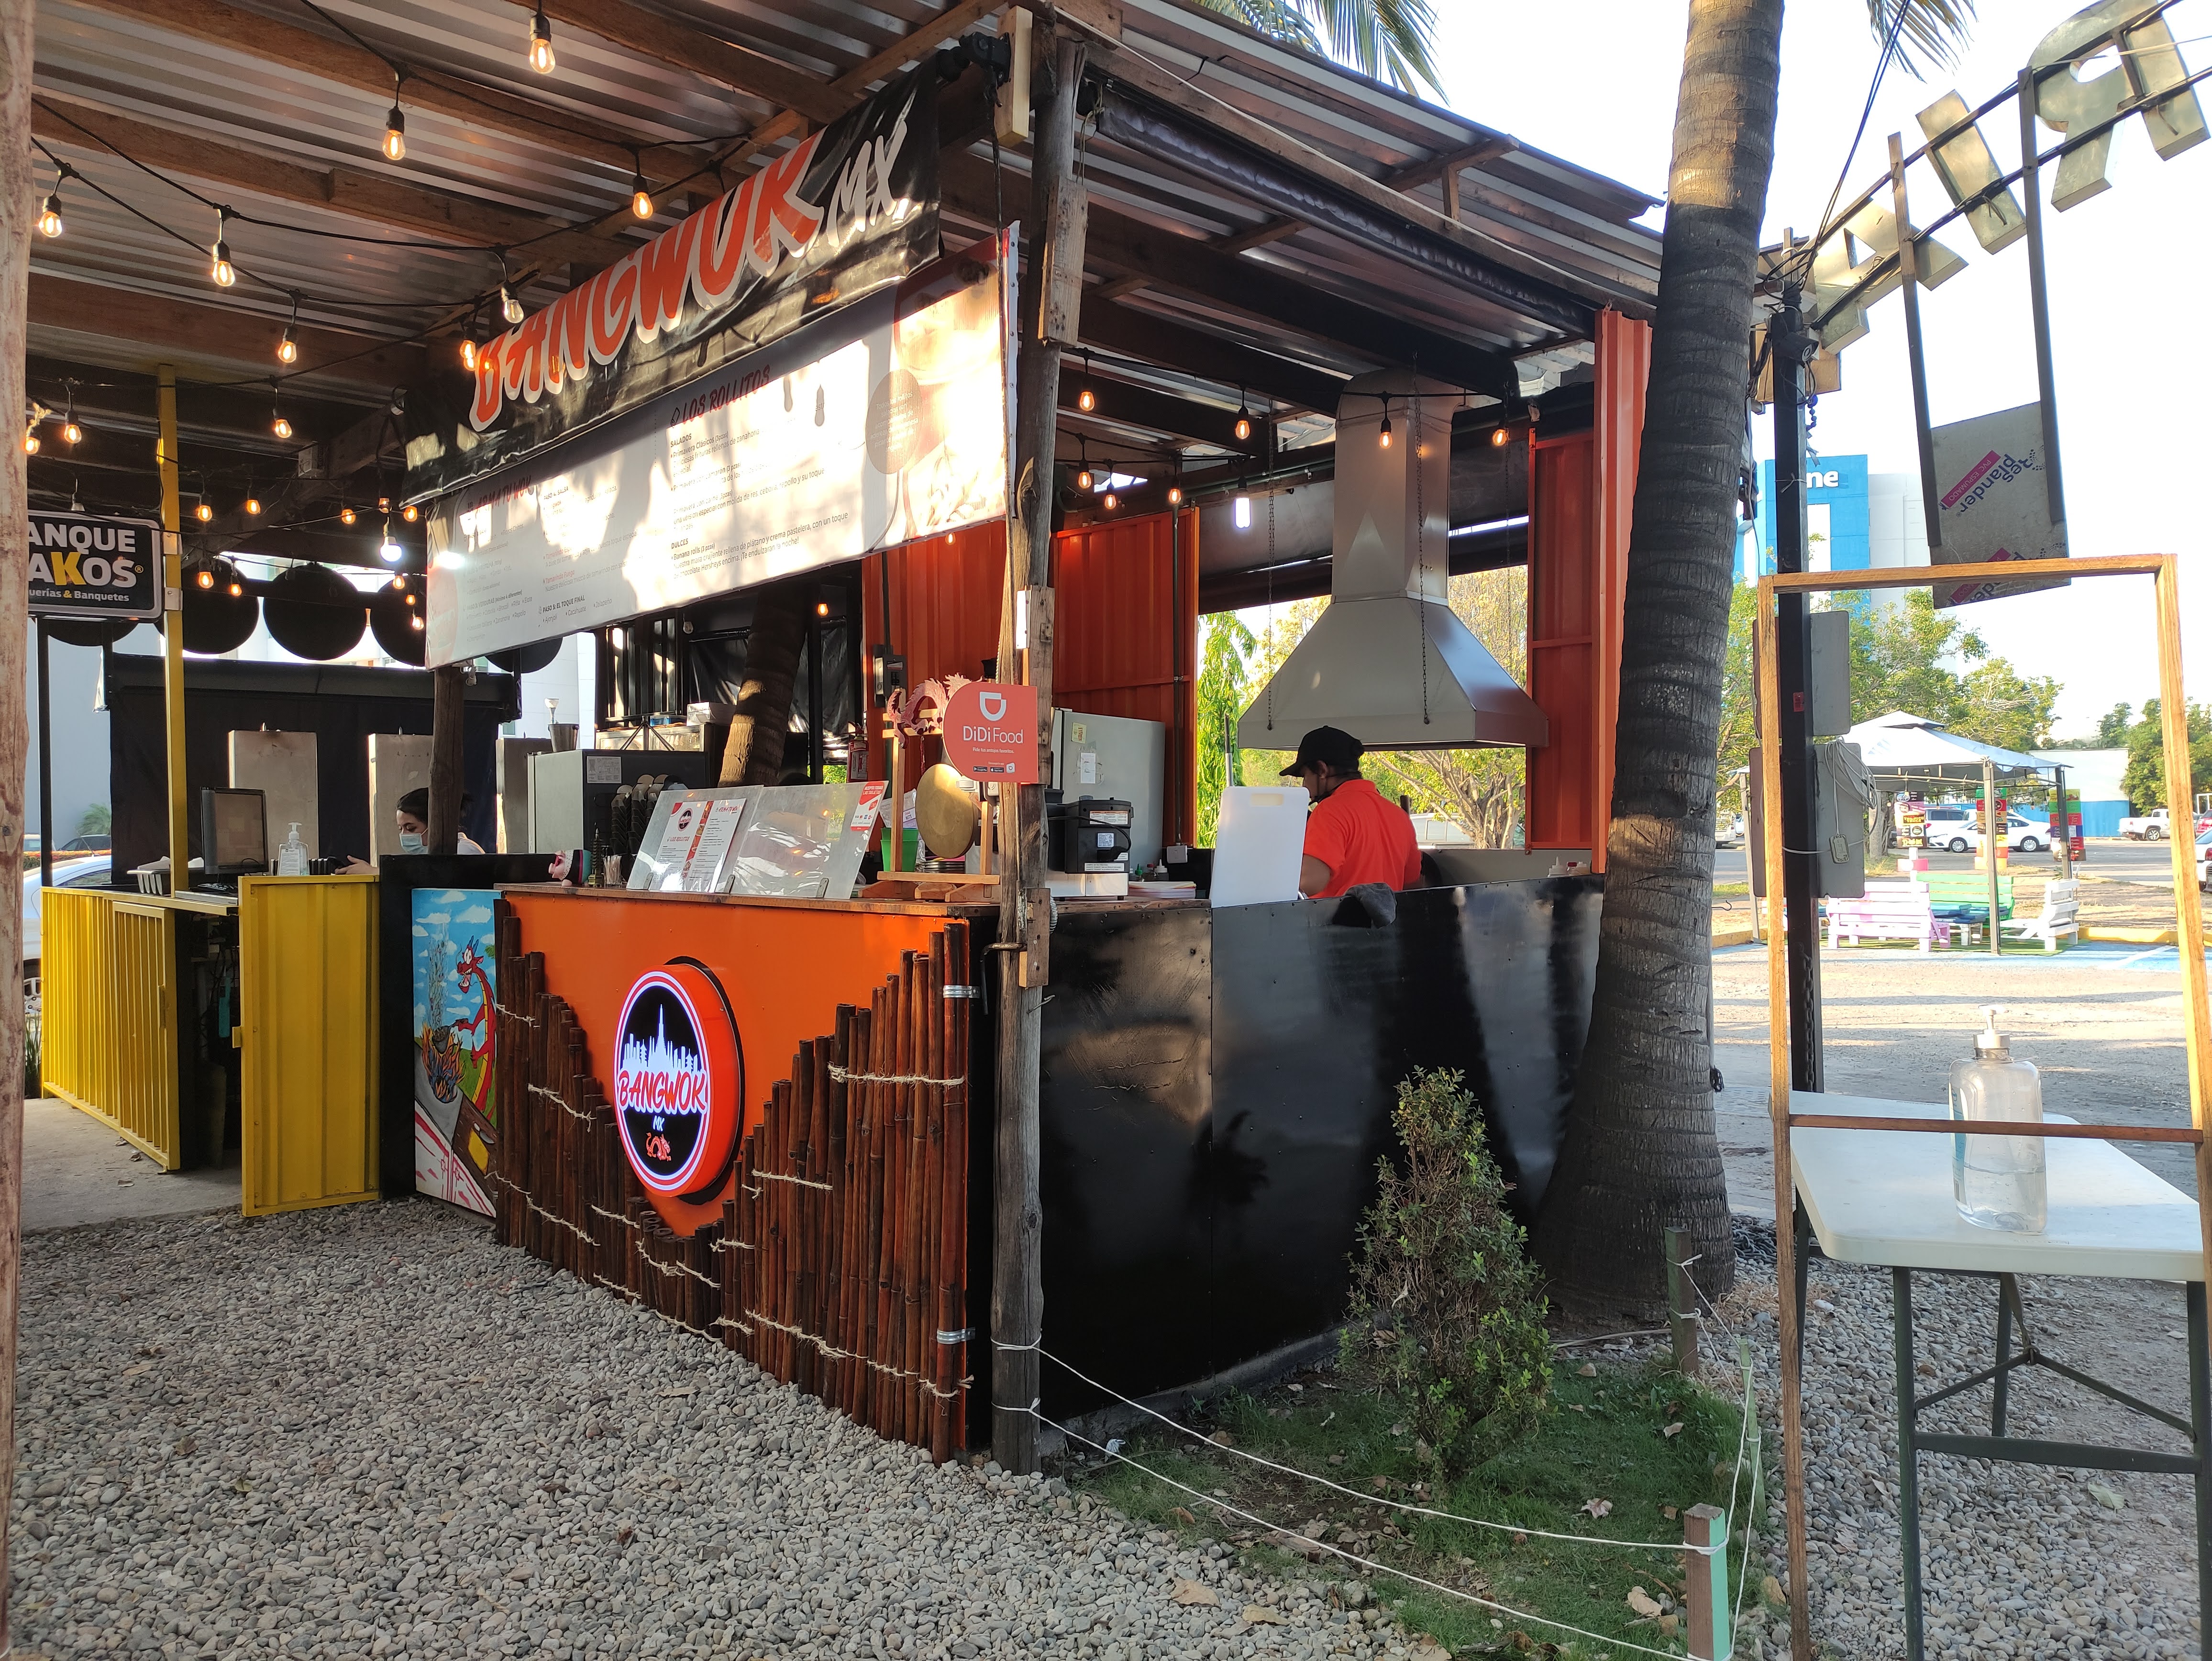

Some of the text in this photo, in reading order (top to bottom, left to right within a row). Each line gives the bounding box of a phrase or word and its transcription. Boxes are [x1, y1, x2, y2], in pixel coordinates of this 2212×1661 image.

[827, 121, 907, 248] MX
[683, 364, 770, 424] LOS ROLLITOS
[671, 433, 692, 448] SALADOS
[674, 445, 695, 458] Primavera
[696, 436, 714, 449] Clásicos
[711, 440, 729, 453] rellenas
[730, 436, 736, 445] de
[737, 429, 760, 442] zanahoria
[727, 474, 733, 482] de
[1806, 470, 1839, 488] ne
[1948, 459, 1992, 501] PVC ESPUMADO
[699, 504, 717, 517] especial
[727, 496, 742, 507] molida
[743, 493, 750, 501] de
[802, 473, 808, 481] su
[809, 468, 825, 479] toque
[28, 521, 136, 554] ANQUE
[671, 538, 688, 550] DULCES
[691, 557, 702, 565] masa
[723, 544, 740, 555] rellena
[740, 542, 746, 551] de
[747, 537, 765, 549] plátano
[766, 536, 770, 544] y
[770, 531, 786, 542] crema
[786, 523, 812, 539] pastelera,
[812, 520, 822, 529] con
[823, 517, 831, 525] un
[831, 512, 848, 525] toque
[674, 550, 690, 561] Banana
[691, 546, 700, 555] rolls
[722, 556, 740, 565] encima.
[782, 536, 799, 547] noche!
[28, 551, 137, 588] AKOS
[29, 588, 62, 598] uerías
[74, 590, 130, 602] Banquetes
[542, 605, 552, 613] PASO
[561, 598, 574, 608] TOQUE
[574, 594, 585, 604] FINAL
[567, 605, 586, 616] Cacahuate
[595, 598, 612, 608] Jalapeño
[619, 1070, 706, 1110] BANGWOK
[653, 1115, 665, 1131] MX
